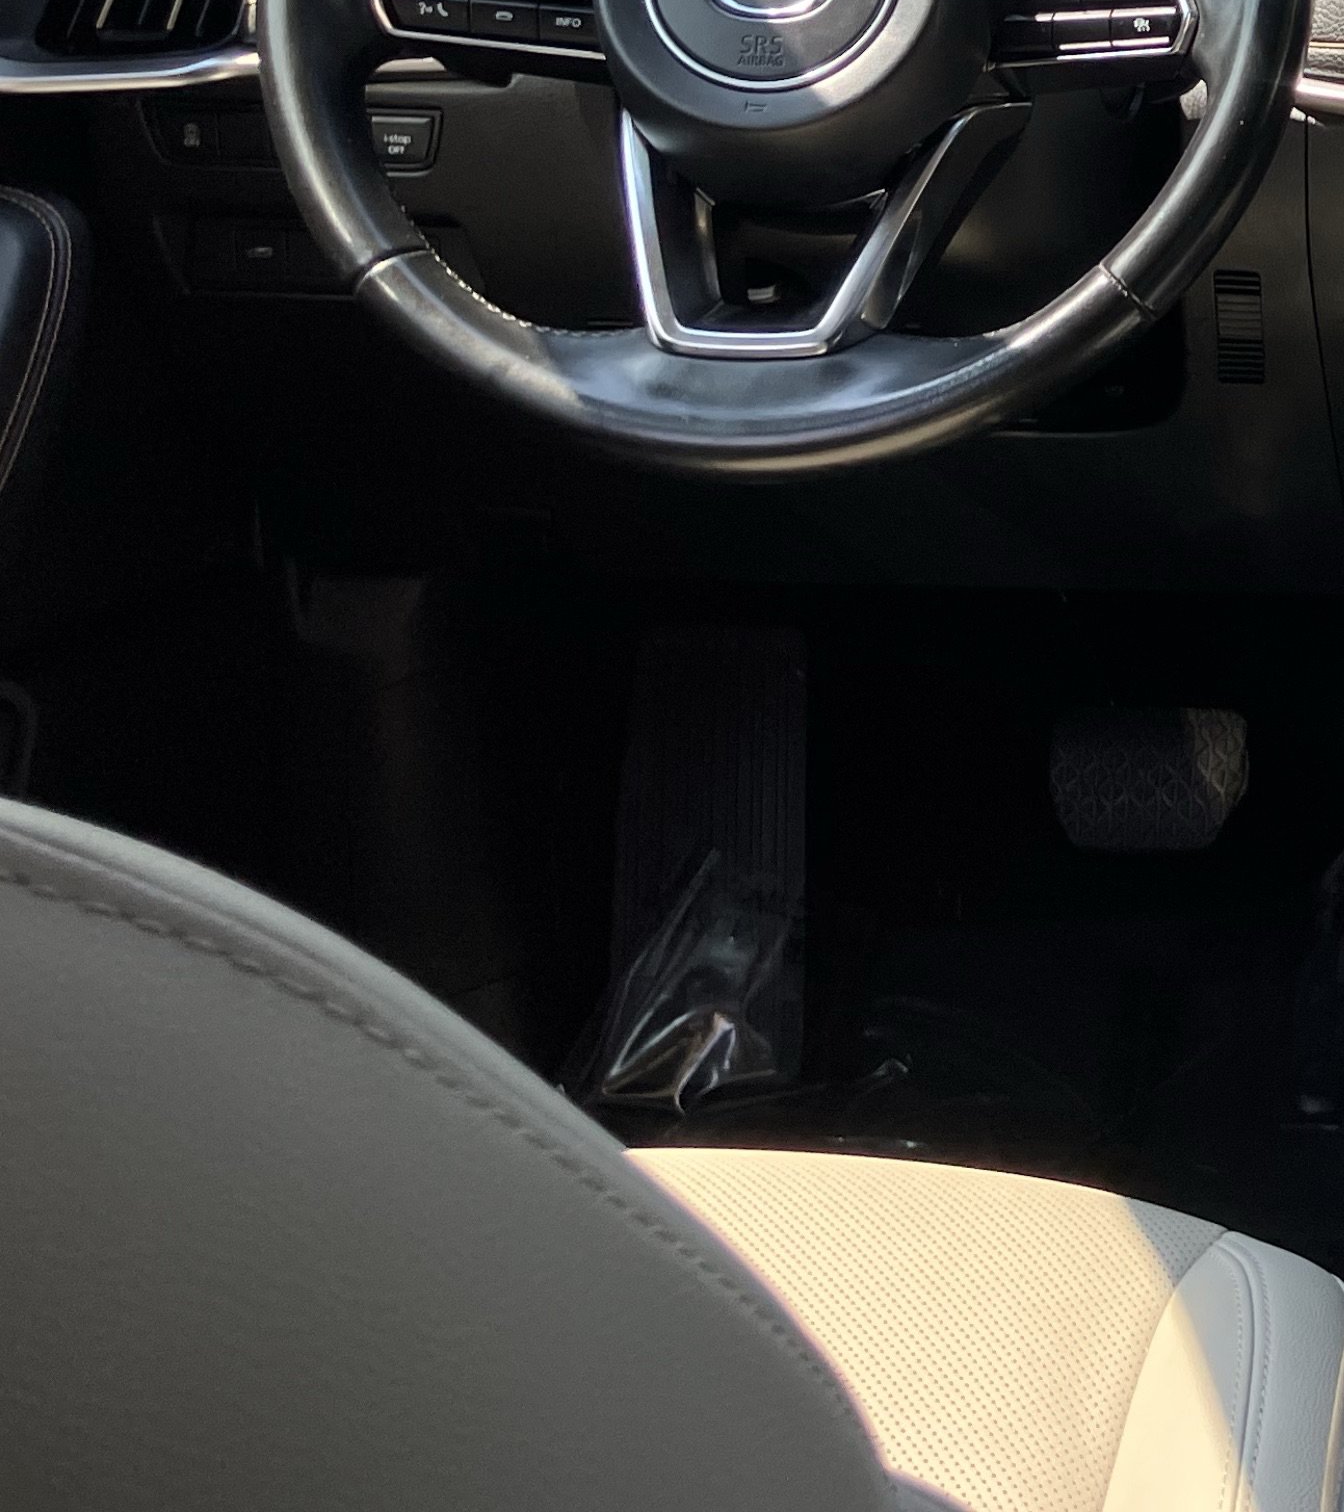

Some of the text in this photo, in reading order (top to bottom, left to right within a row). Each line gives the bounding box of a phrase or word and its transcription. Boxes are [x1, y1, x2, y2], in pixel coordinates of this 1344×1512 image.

[555, 16, 582, 28] INFO
[739, 34, 782, 54] SRS
[737, 55, 784, 67] AIRBAG
